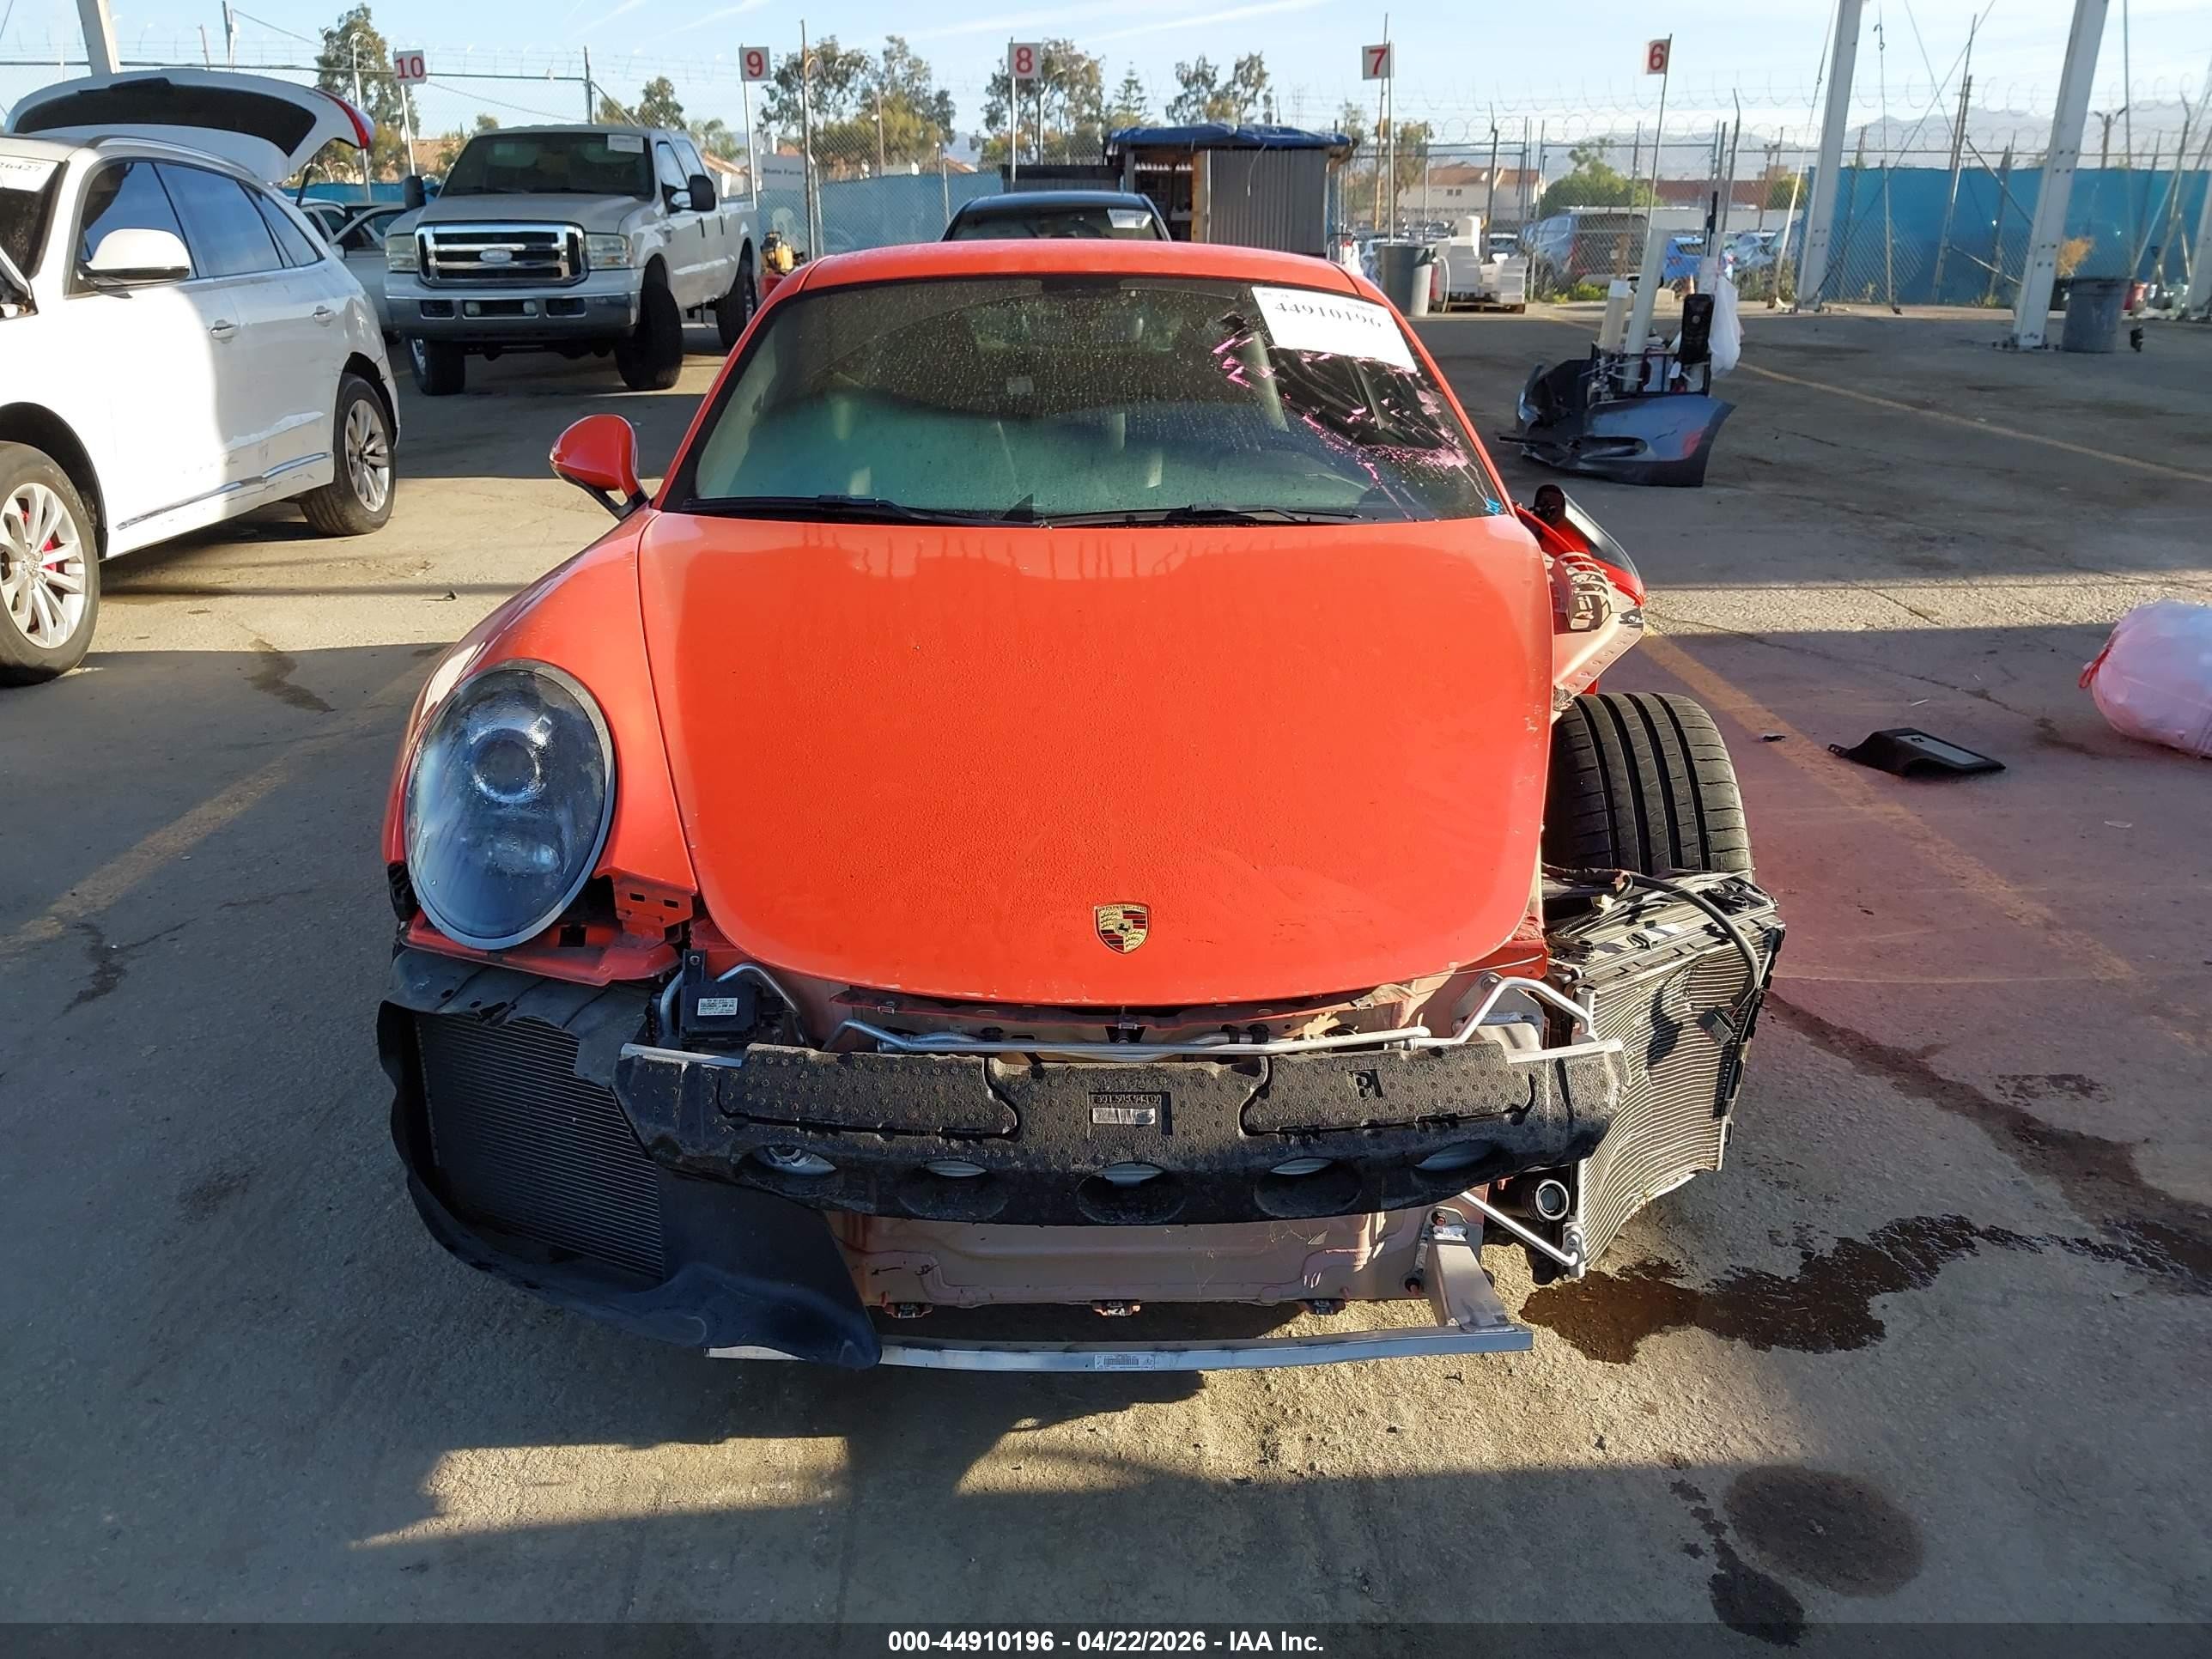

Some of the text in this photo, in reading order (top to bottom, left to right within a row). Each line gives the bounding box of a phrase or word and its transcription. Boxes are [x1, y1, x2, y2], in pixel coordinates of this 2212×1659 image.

[395, 56, 425, 79] 10
[746, 51, 763, 77] 9
[1016, 46, 1033, 74] 8
[1368, 48, 1387, 76] 7
[1650, 43, 1664, 70] 6
[1275, 301, 1382, 328] 44910196
[1099, 904, 1146, 913] PORSCHE
